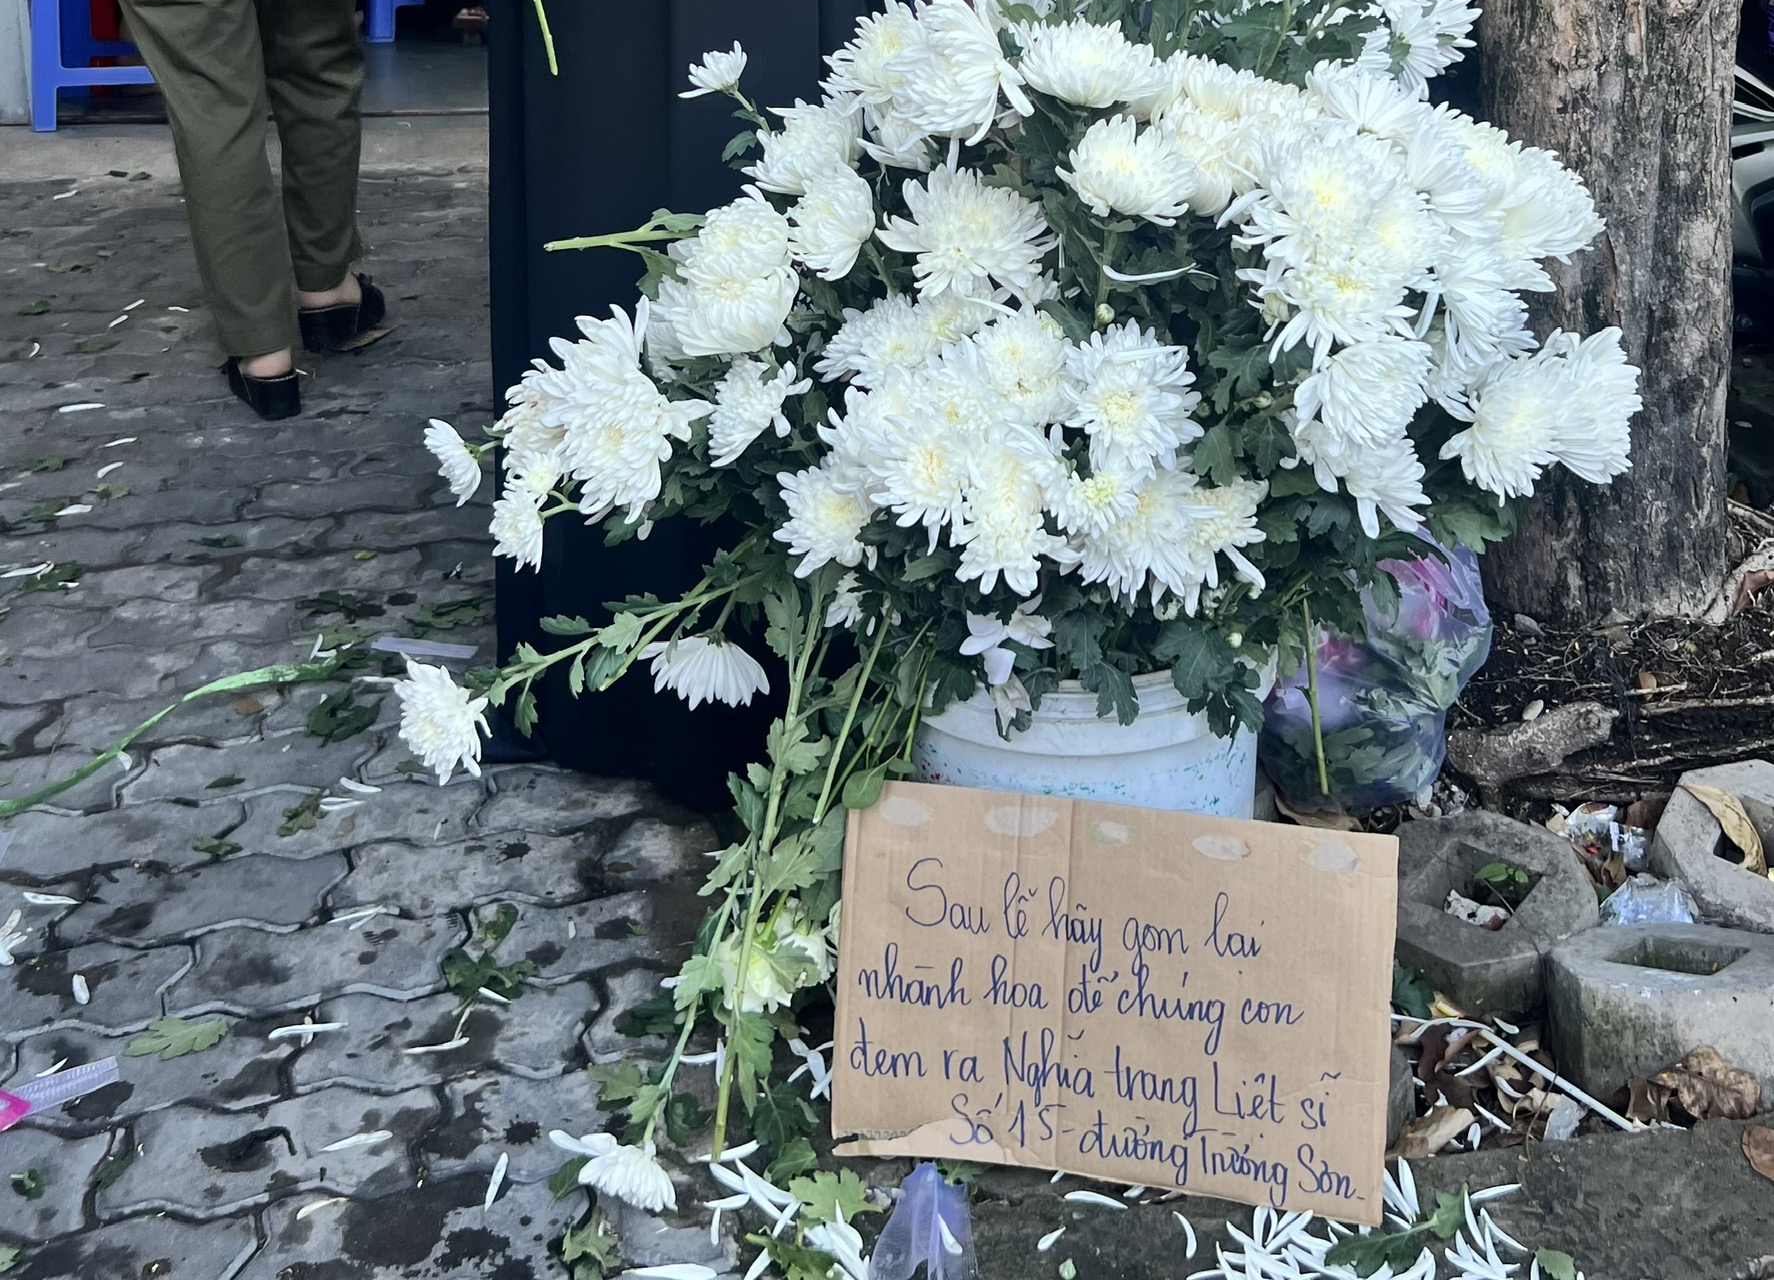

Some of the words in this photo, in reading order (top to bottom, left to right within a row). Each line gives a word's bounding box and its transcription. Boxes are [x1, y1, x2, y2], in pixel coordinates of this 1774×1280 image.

[906, 857, 990, 935] Sau
[1003, 871, 1038, 939] lễ
[1041, 876, 1103, 974] hãy
[1122, 917, 1189, 977] gom
[983, 954, 1049, 1010] hoa
[1067, 964, 1119, 1014] để
[1117, 963, 1226, 1056] chúng
[1240, 996, 1304, 1026] con
[850, 1017, 927, 1079] đem
[943, 1049, 984, 1083] ra
[1003, 1027, 1096, 1107] Nghĩa
[1104, 1045, 1199, 1137] trang
[1300, 1071, 1341, 1130] sĩ
[949, 1092, 1003, 1145] Số
